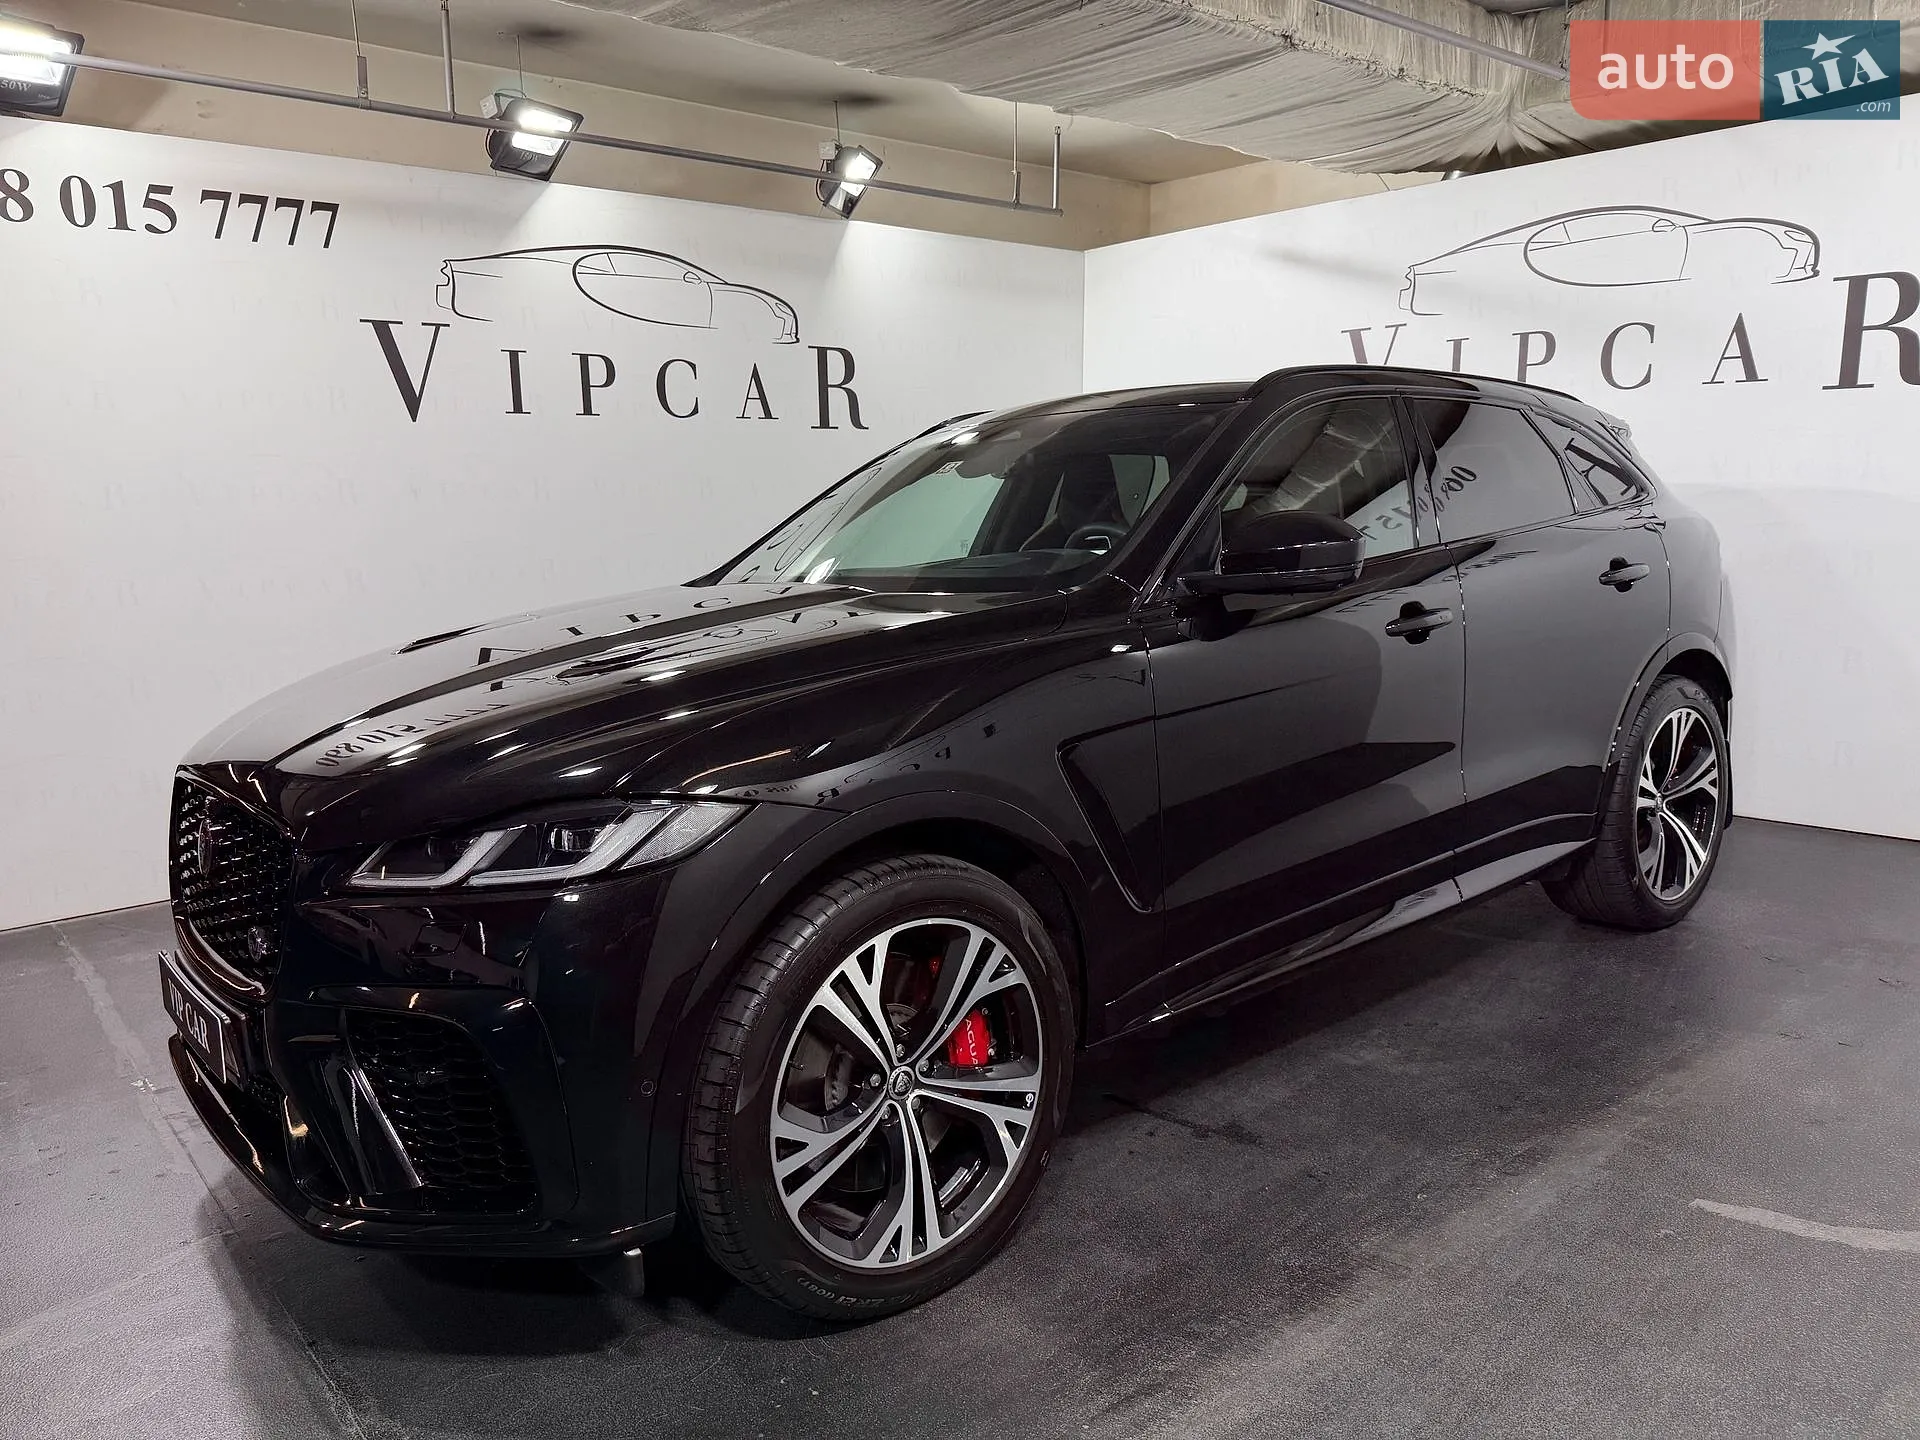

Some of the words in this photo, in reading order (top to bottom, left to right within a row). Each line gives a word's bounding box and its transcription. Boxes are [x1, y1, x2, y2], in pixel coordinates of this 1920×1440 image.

[59, 175, 178, 235] 015
[200, 189, 340, 249] 7777
[360, 319, 869, 430] VIPCAR
[167, 977, 184, 1022] VIP
[185, 1002, 211, 1054] CAR
